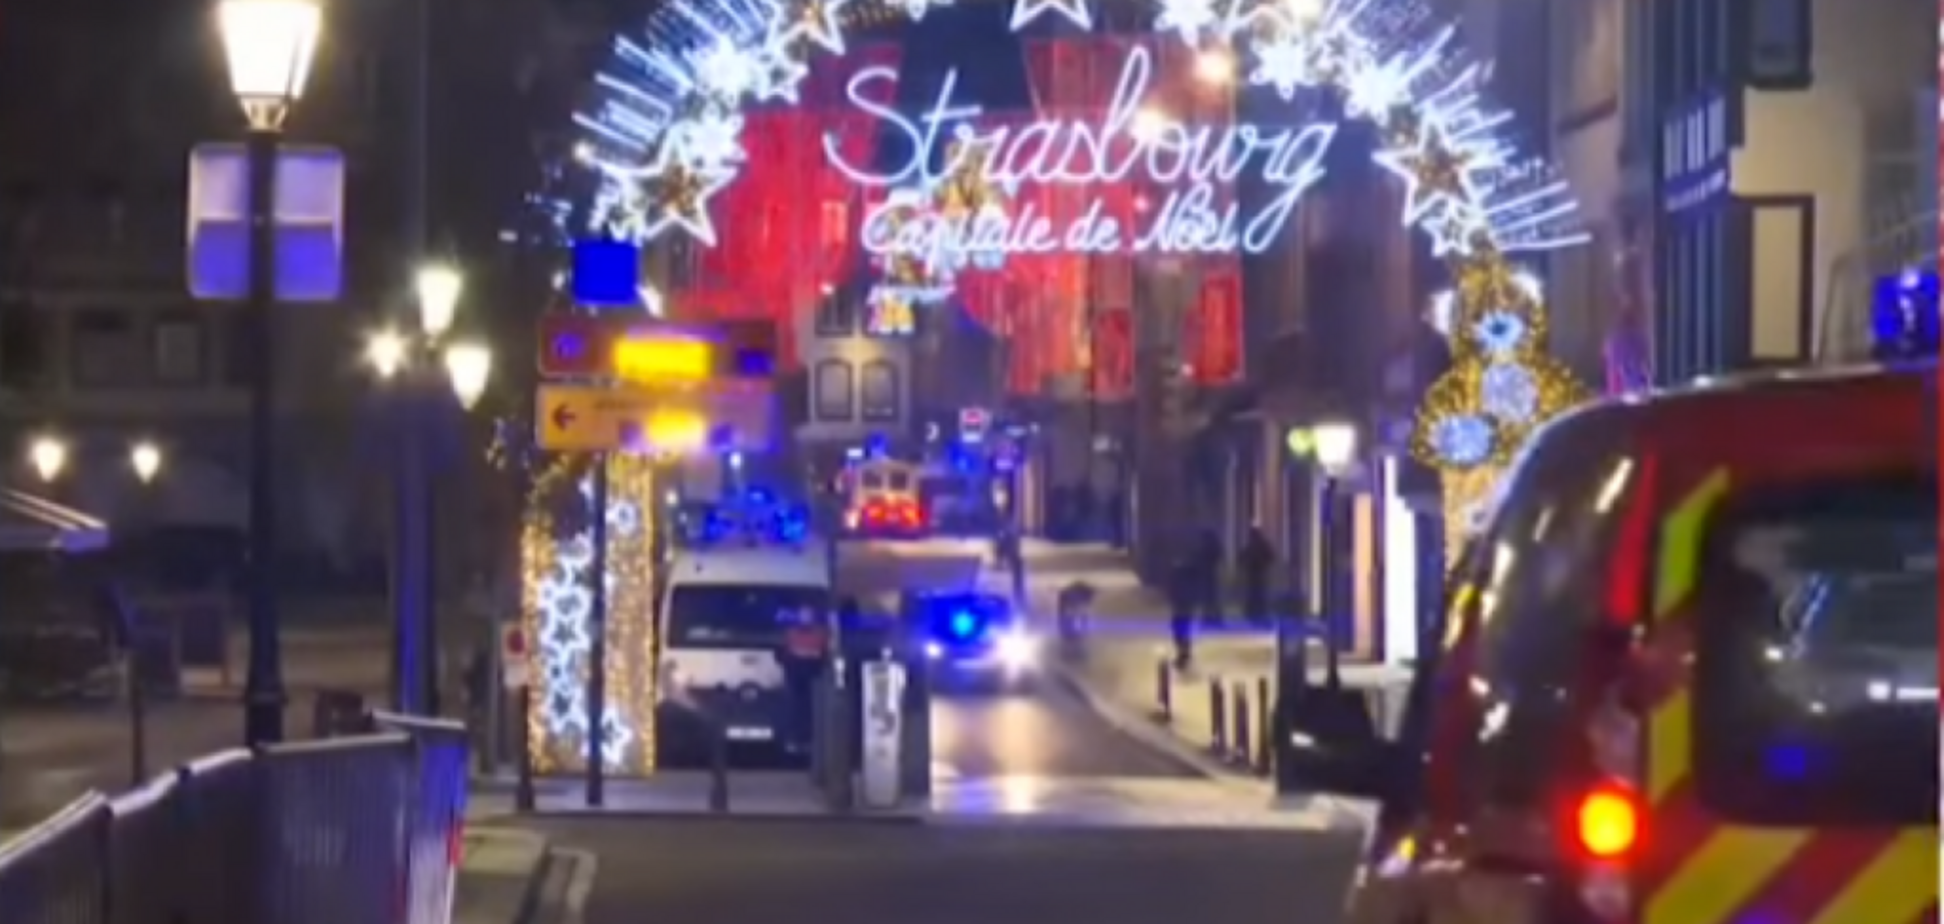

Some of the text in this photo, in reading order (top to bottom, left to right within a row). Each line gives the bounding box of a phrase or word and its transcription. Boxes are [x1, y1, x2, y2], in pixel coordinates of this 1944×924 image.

[822, 45, 1338, 254] Strasbourg
[861, 181, 1241, 264] Capitale de Noël
